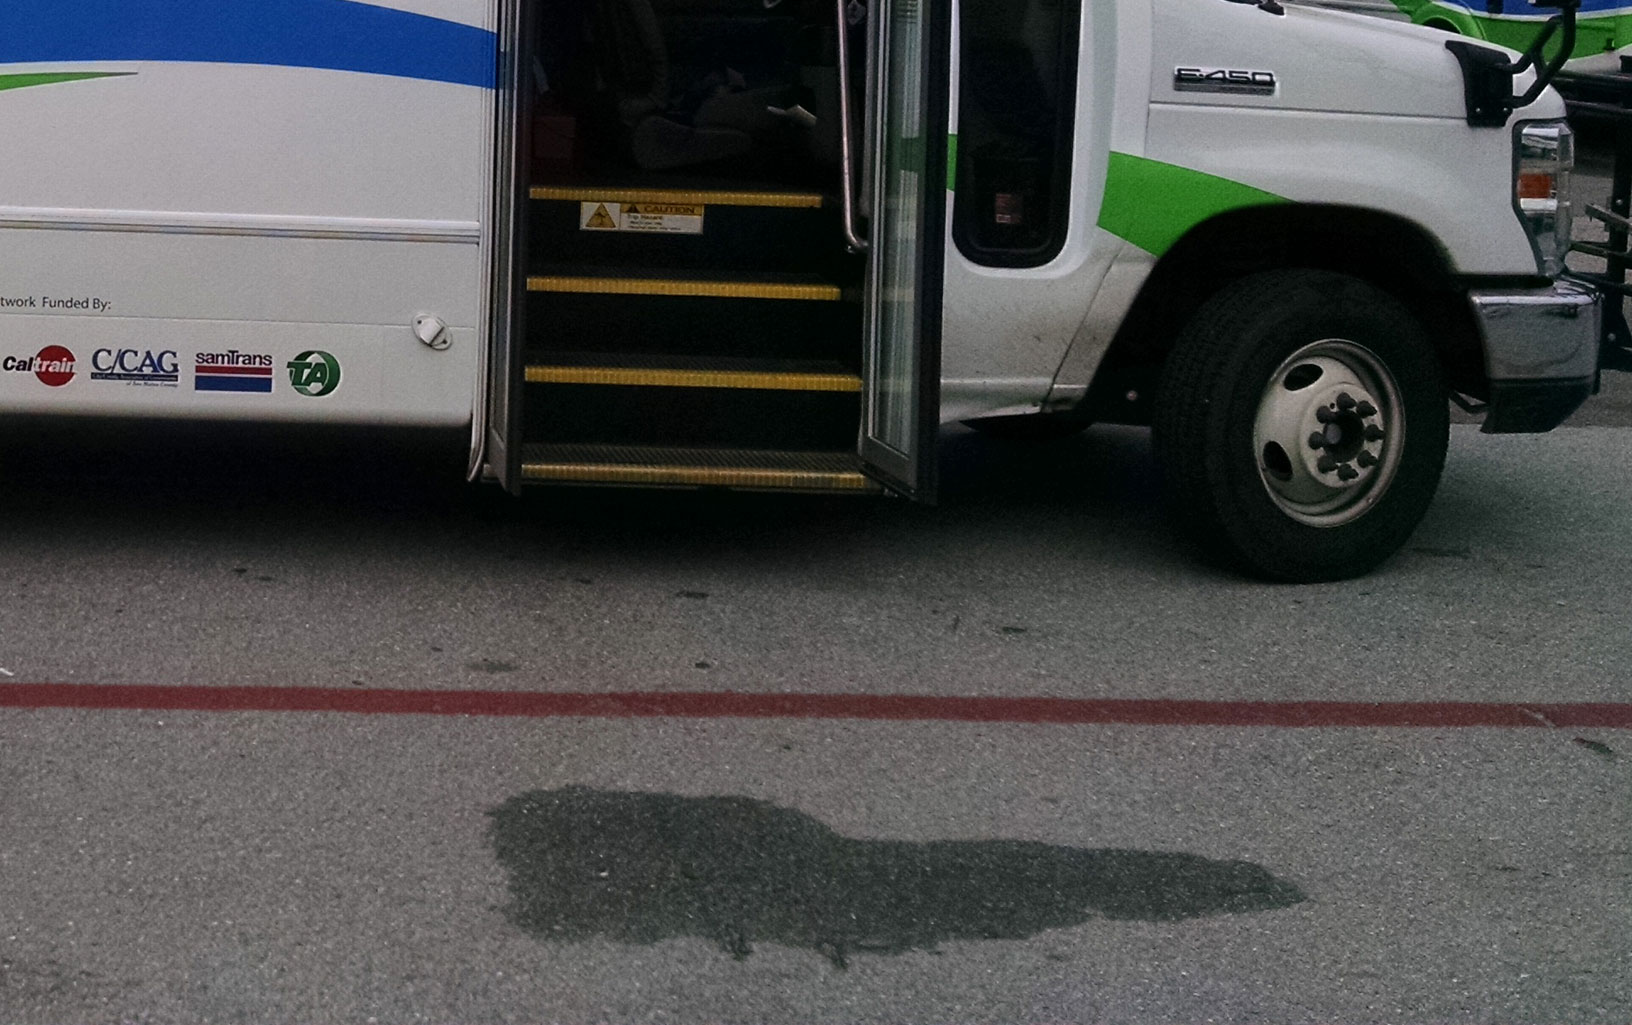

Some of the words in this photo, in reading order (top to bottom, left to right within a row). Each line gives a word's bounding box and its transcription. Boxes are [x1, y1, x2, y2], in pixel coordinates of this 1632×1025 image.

[644, 205, 695, 214] CAUTION
[42, 296, 89, 310] Funded
[92, 298, 111, 312] By:
[3, 355, 76, 373] Caltrain
[92, 348, 180, 374] C/CAG
[195, 350, 272, 366] samTrans
[286, 361, 326, 387] TA
